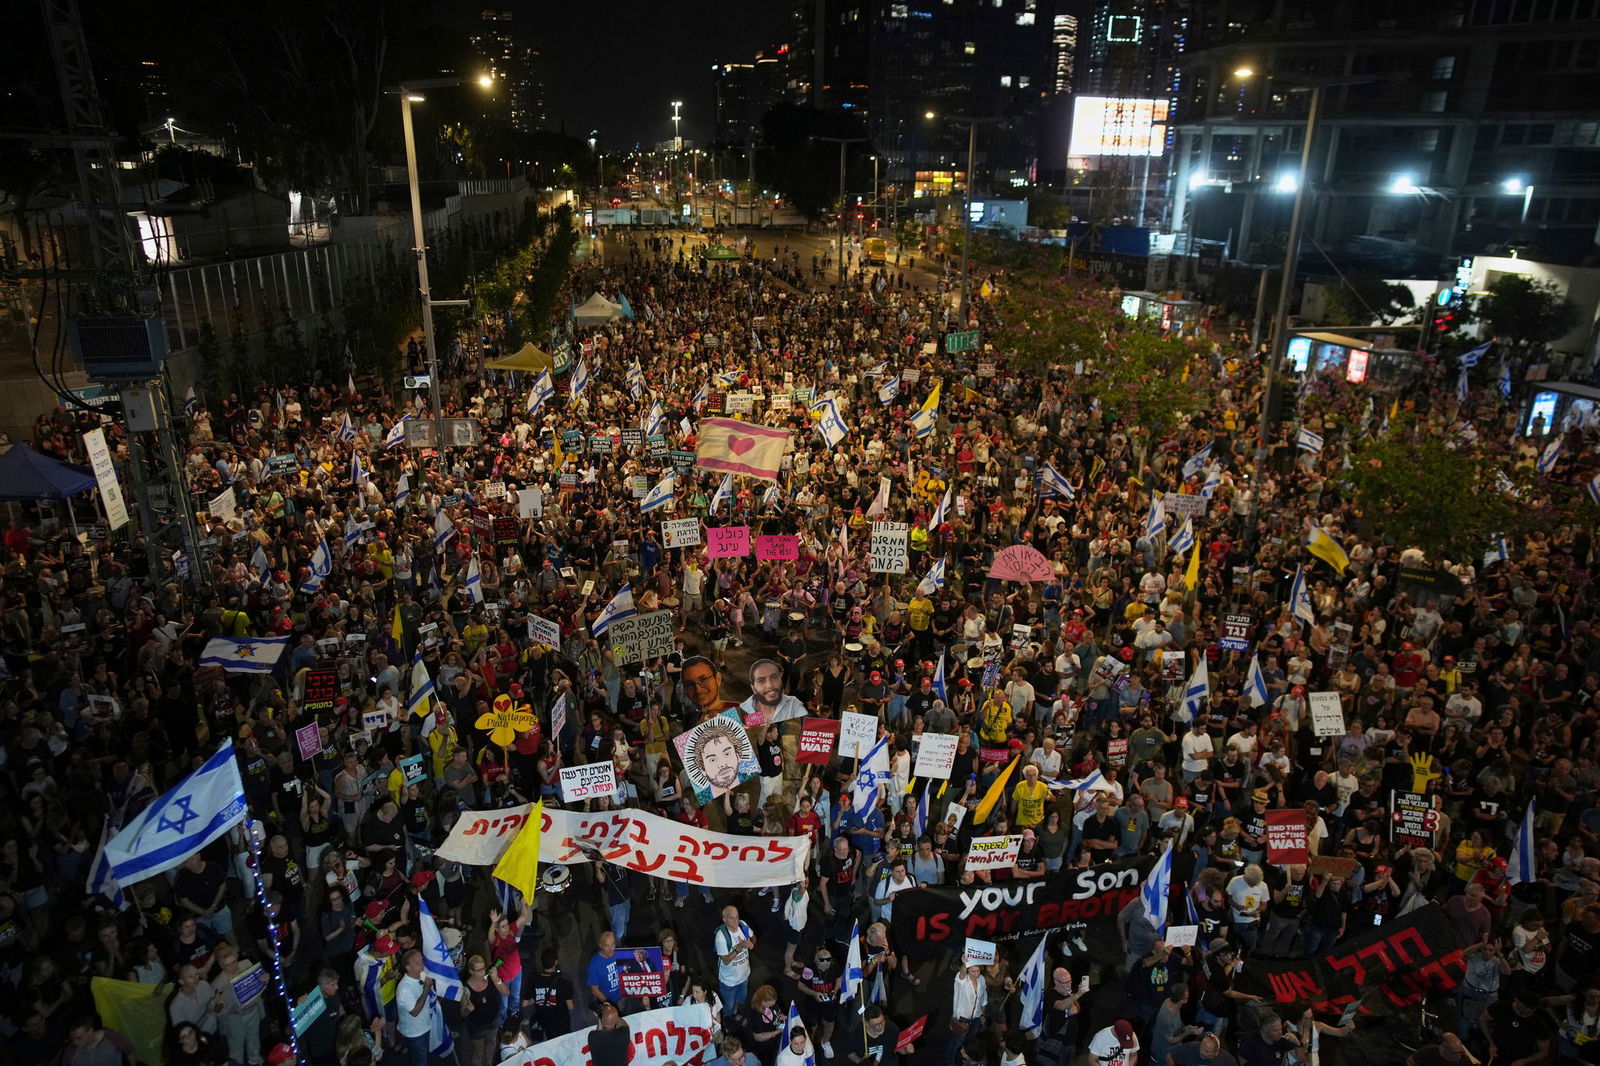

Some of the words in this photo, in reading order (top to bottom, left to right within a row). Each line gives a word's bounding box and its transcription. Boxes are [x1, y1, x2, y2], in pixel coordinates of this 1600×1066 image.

[716, 527, 743, 539] כולנו
[872, 535, 904, 545] ממשלה
[717, 541, 739, 552] עינב
[872, 546, 904, 556] בוגדת
[870, 556, 903, 569] בעמה
[1226, 614, 1250, 623] נתניהו
[611, 619, 634, 633] בשם
[1226, 625, 1247, 637] נגד
[531, 630, 558, 647] הביתה
[1221, 639, 1248, 650] ישראל
[306, 674, 335, 685] ביבי
[305, 687, 335, 697] בוגד
[1321, 703, 1331, 711] על
[486, 718, 508, 728] Pinta
[818, 730, 834, 738] THIS
[1320, 726, 1341, 735] אשם
[800, 742, 831, 752] WAR
[579, 813, 650, 845] בלתי
[677, 834, 793, 864] לחימה
[1268, 838, 1306, 850] WAR
[959, 881, 1046, 919] your
[1072, 868, 1139, 900] Son
[916, 911, 951, 942] IS
[964, 909, 1020, 936] MY
[1326, 925, 1432, 985] חדל
[622, 974, 640, 982] END
[641, 972, 660, 981] THIS
[623, 985, 662, 995] WAR
[1267, 968, 1324, 1003] אש
